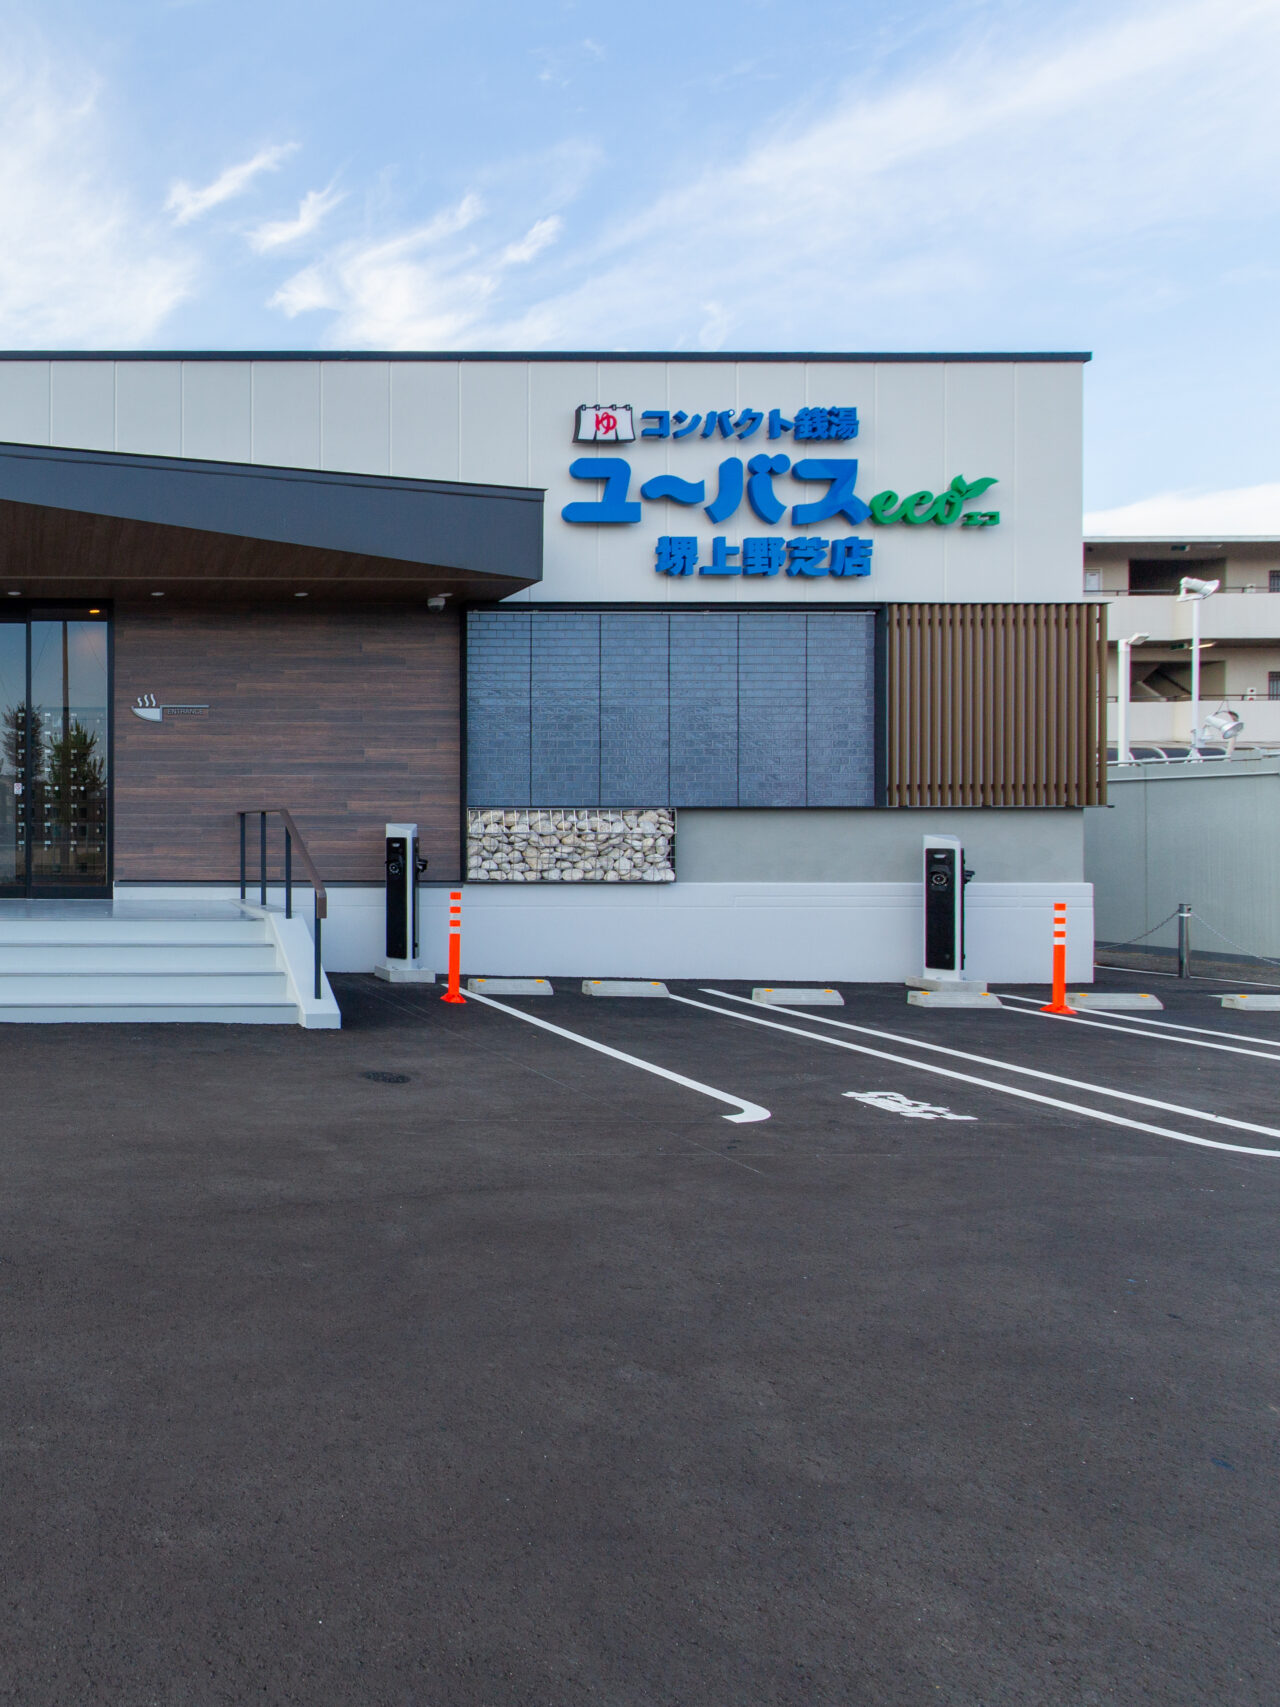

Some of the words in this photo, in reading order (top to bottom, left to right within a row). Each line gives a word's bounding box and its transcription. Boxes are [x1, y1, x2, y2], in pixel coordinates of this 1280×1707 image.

[594, 411, 618, 435] ゆ
[640, 406, 860, 440] コンパクト銭湯
[869, 482, 970, 525] eco
[961, 511, 1001, 527] エコ
[654, 535, 874, 577] 堺上野芝店
